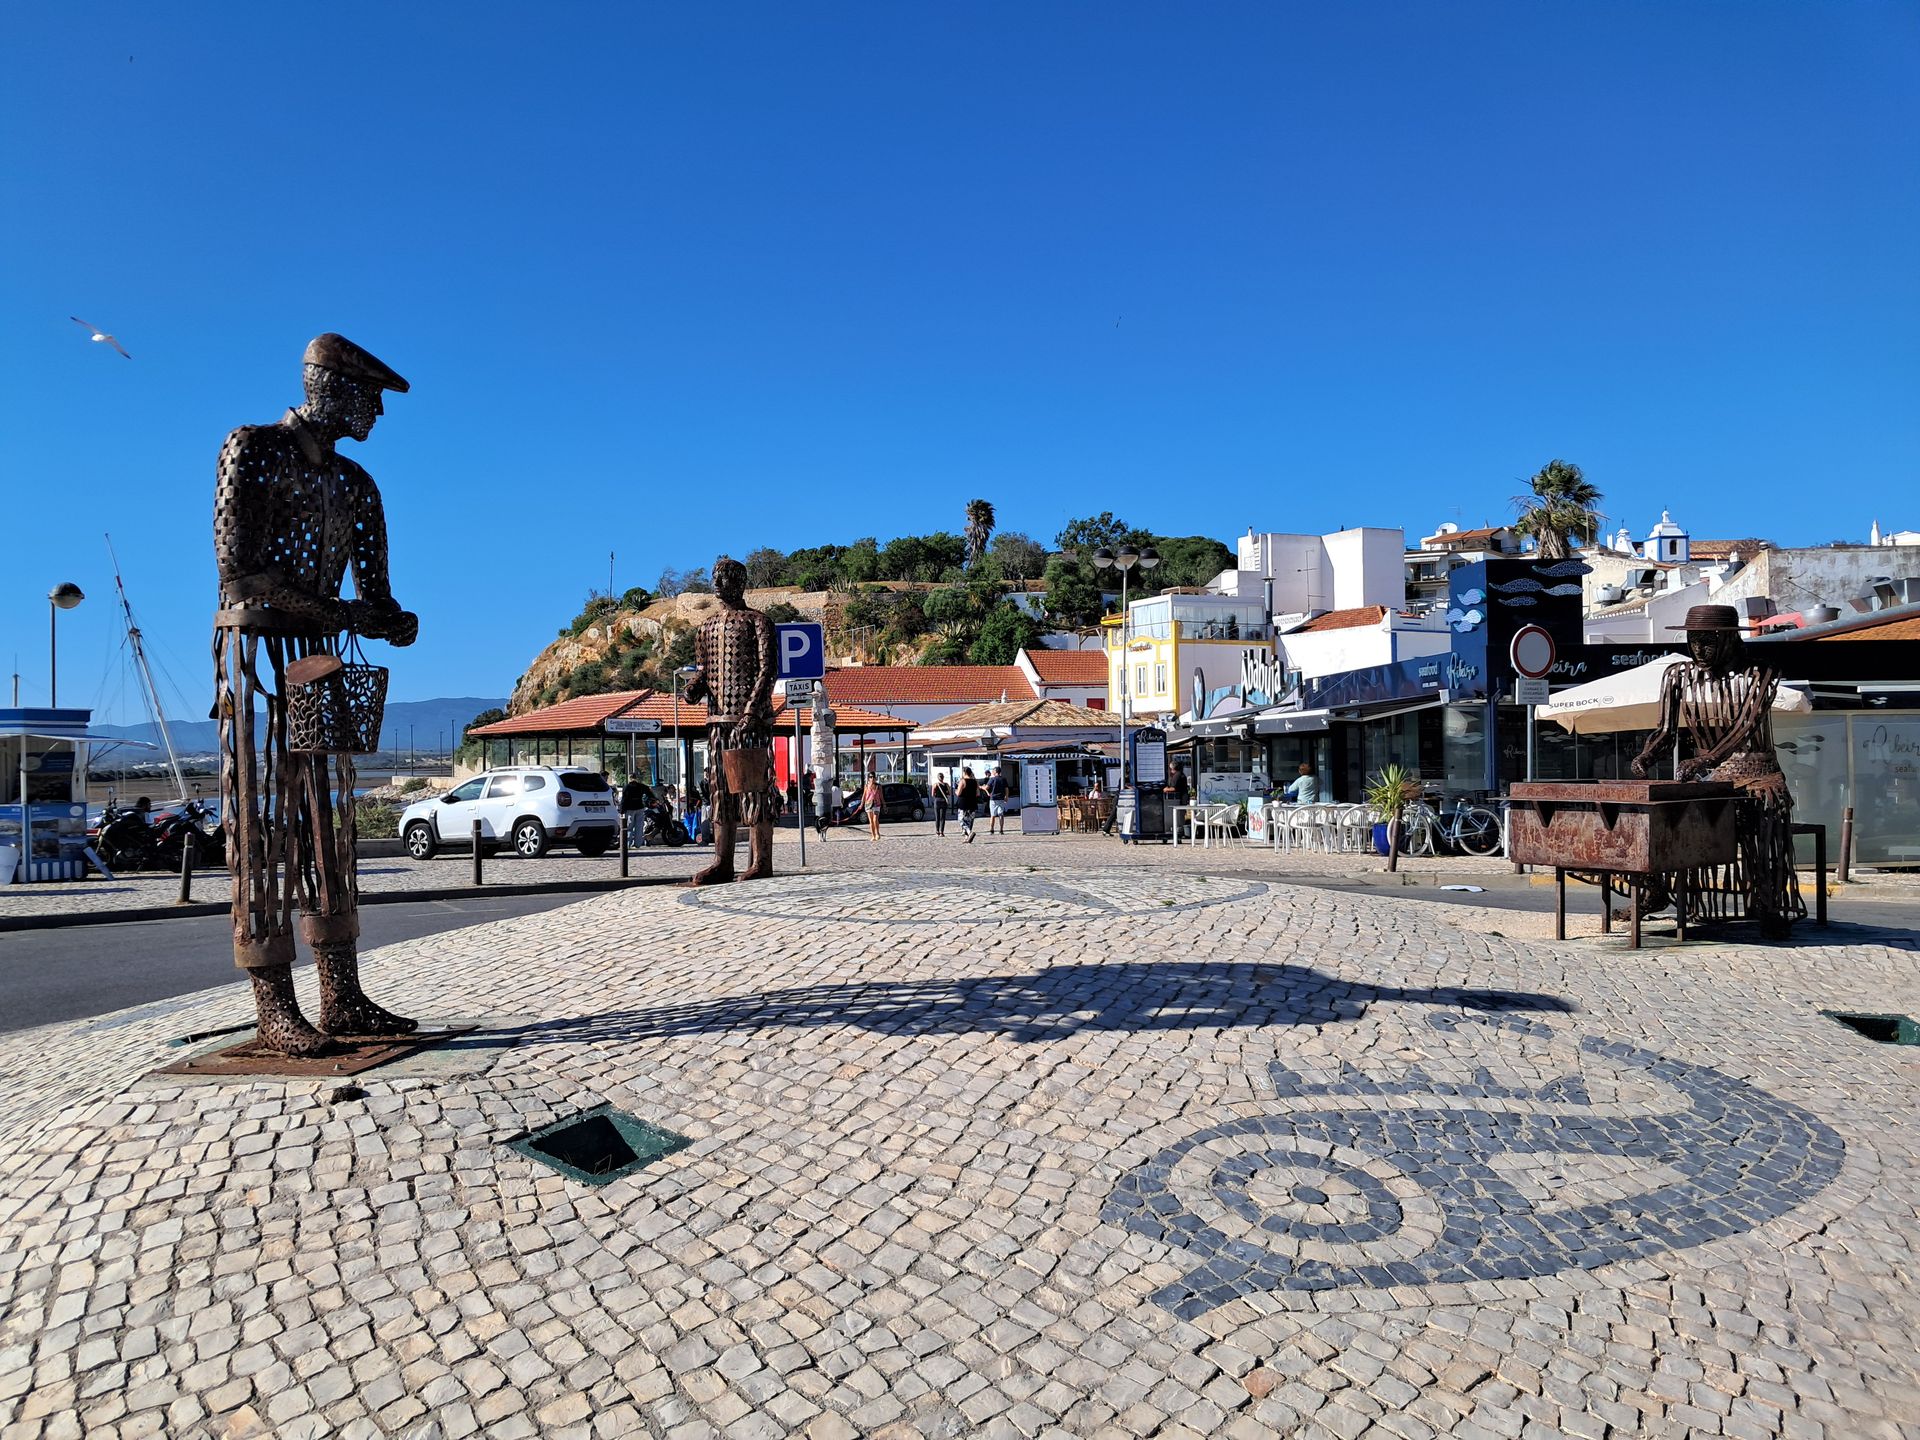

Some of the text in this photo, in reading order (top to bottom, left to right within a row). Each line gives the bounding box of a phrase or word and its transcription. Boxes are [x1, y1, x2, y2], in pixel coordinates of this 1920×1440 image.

[781, 630, 810, 673] P
[1549, 701, 1574, 709] SUPER
[1576, 697, 1599, 707] BOCK
